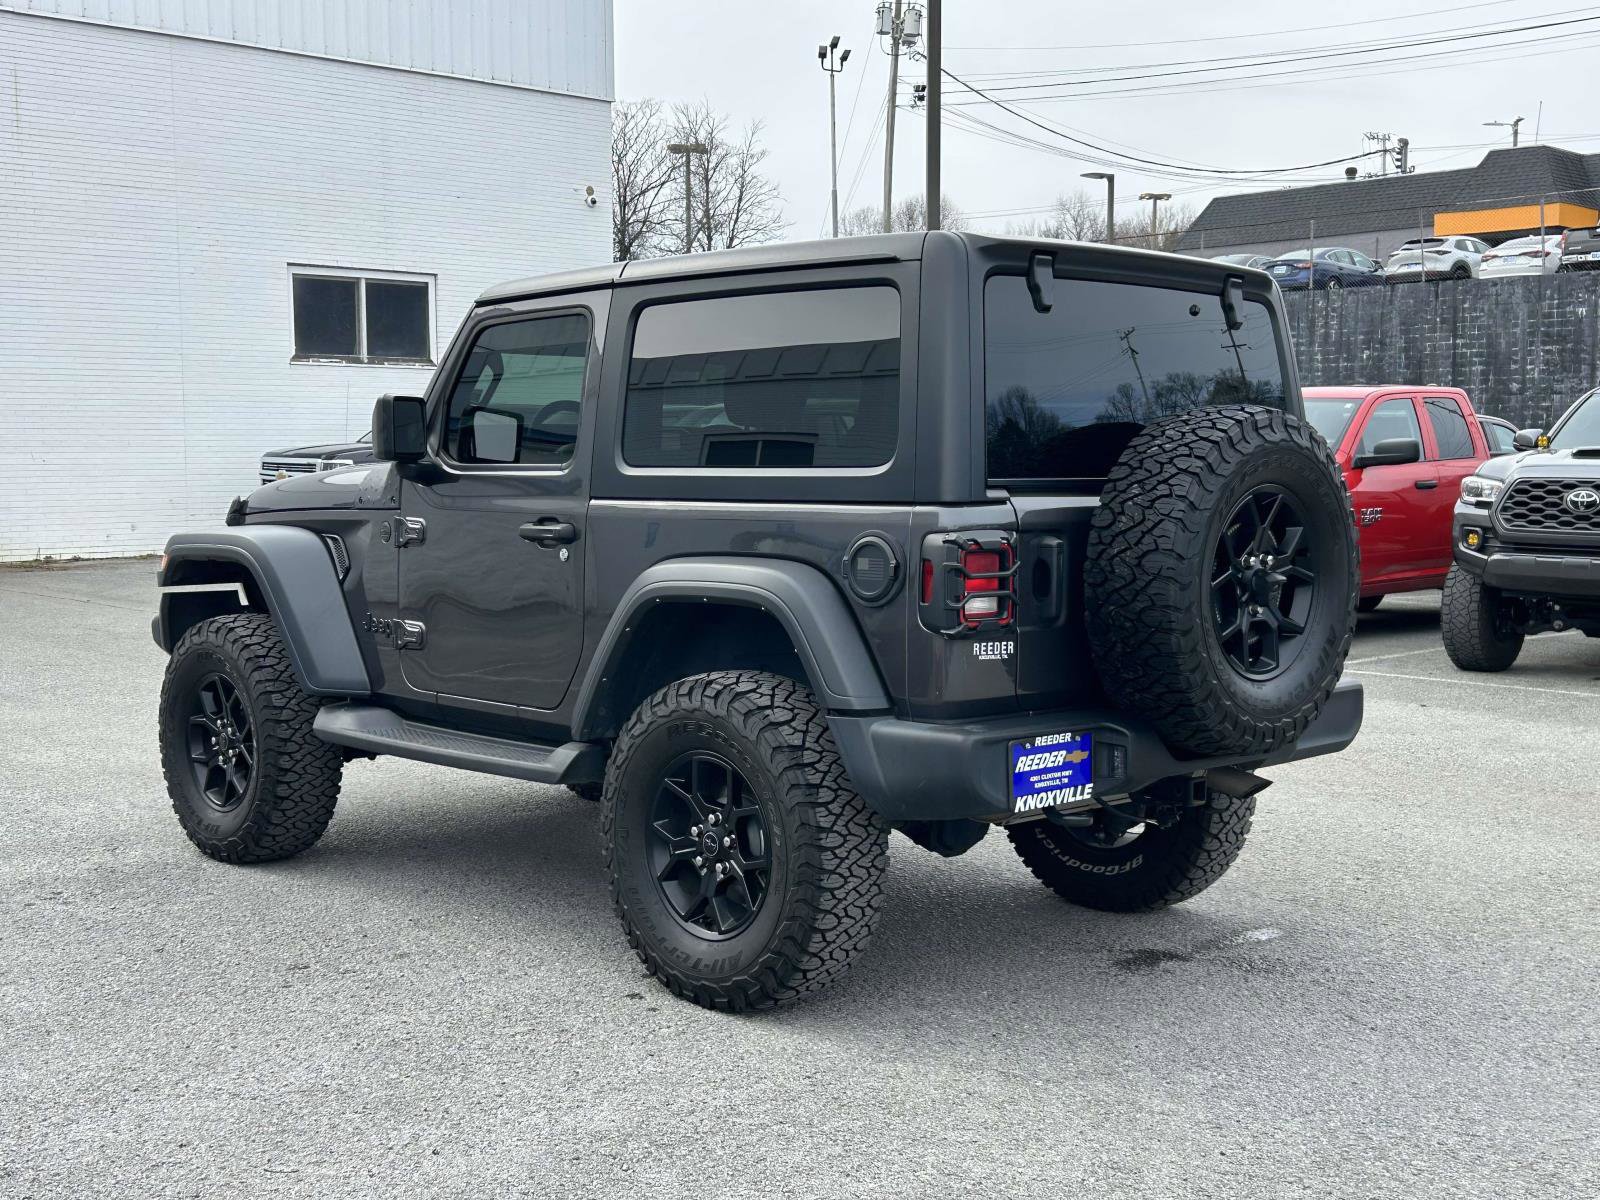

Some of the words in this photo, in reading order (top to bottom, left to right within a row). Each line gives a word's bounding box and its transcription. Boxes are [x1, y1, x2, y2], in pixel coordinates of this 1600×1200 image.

[362, 611, 392, 638] Jeep
[973, 641, 1014, 655] REEDER
[1034, 732, 1072, 747] REEDER
[1014, 750, 1067, 773] REEDER
[1014, 783, 1094, 813] KNOXVILLE
[1034, 827, 1144, 876] BFGoodrich
